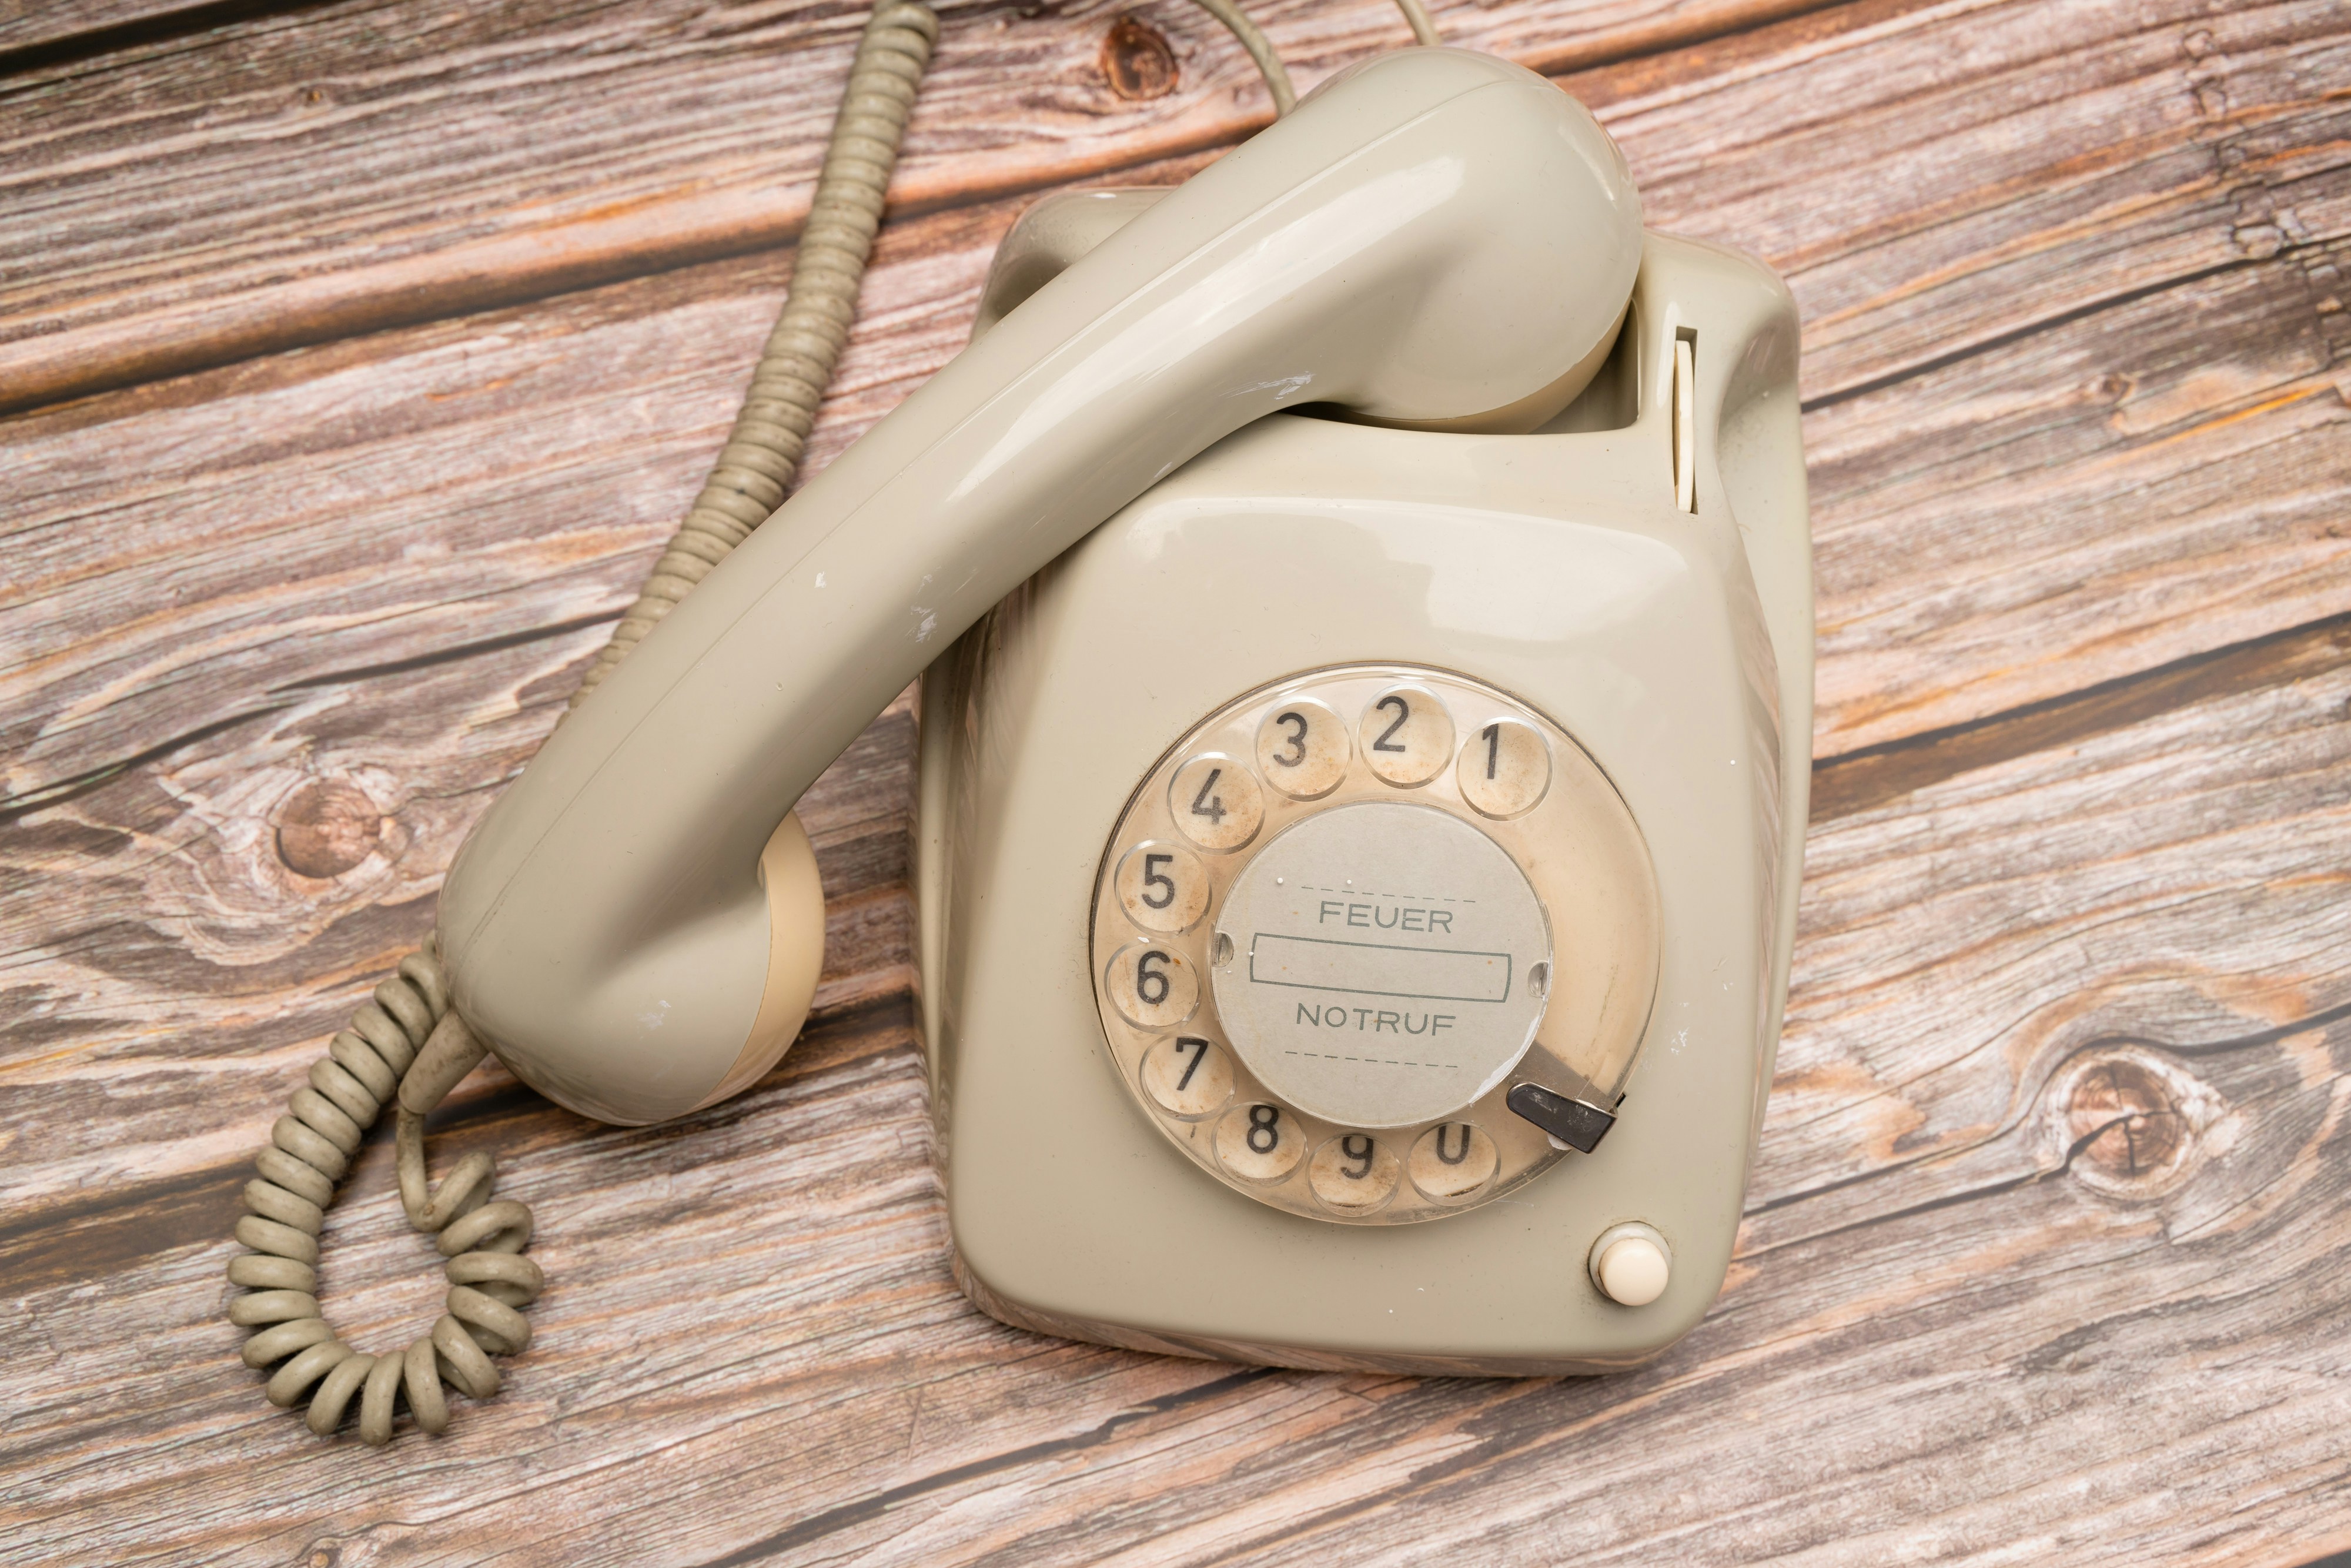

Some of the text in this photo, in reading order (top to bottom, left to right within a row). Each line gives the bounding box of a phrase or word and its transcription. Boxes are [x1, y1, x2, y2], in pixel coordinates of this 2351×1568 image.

[1273, 713, 1308, 768] 3
[1373, 696, 1409, 752] 2
[1482, 724, 1499, 780] 1
[1192, 768, 1226, 824] 4
[1142, 854, 1175, 908] 5
[1319, 900, 1453, 934] FEUER
[1137, 951, 1170, 1004] 6
[1296, 1002, 1456, 1036] NOTRUF
[1175, 1038, 1208, 1091] 7
[1246, 1105, 1279, 1154] 8
[1437, 1125, 1470, 1165] 0
[1340, 1136, 1374, 1179] 9
